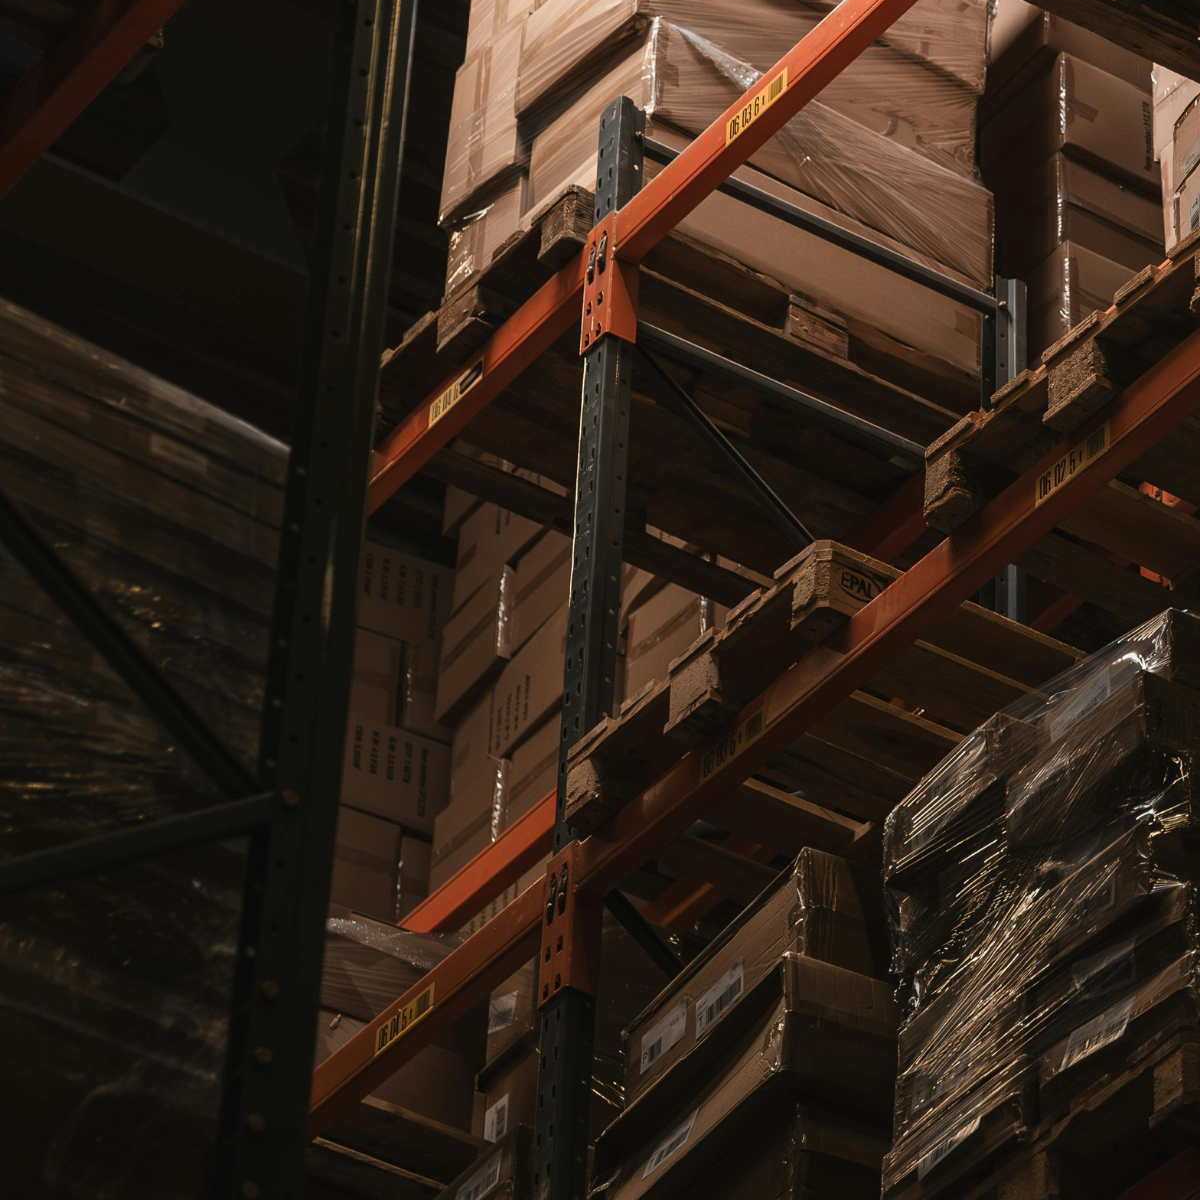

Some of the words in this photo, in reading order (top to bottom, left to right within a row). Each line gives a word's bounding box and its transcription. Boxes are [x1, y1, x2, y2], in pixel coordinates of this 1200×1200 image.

[729, 115, 740, 140] 06
[742, 104, 752, 128] 03
[754, 96, 760, 116] 6
[1040, 470, 1051, 500] 06
[1055, 459, 1066, 487] 02
[1069, 451, 1075, 475] 5
[378, 1024, 388, 1051] 06
[402, 1008, 407, 1031] 5
